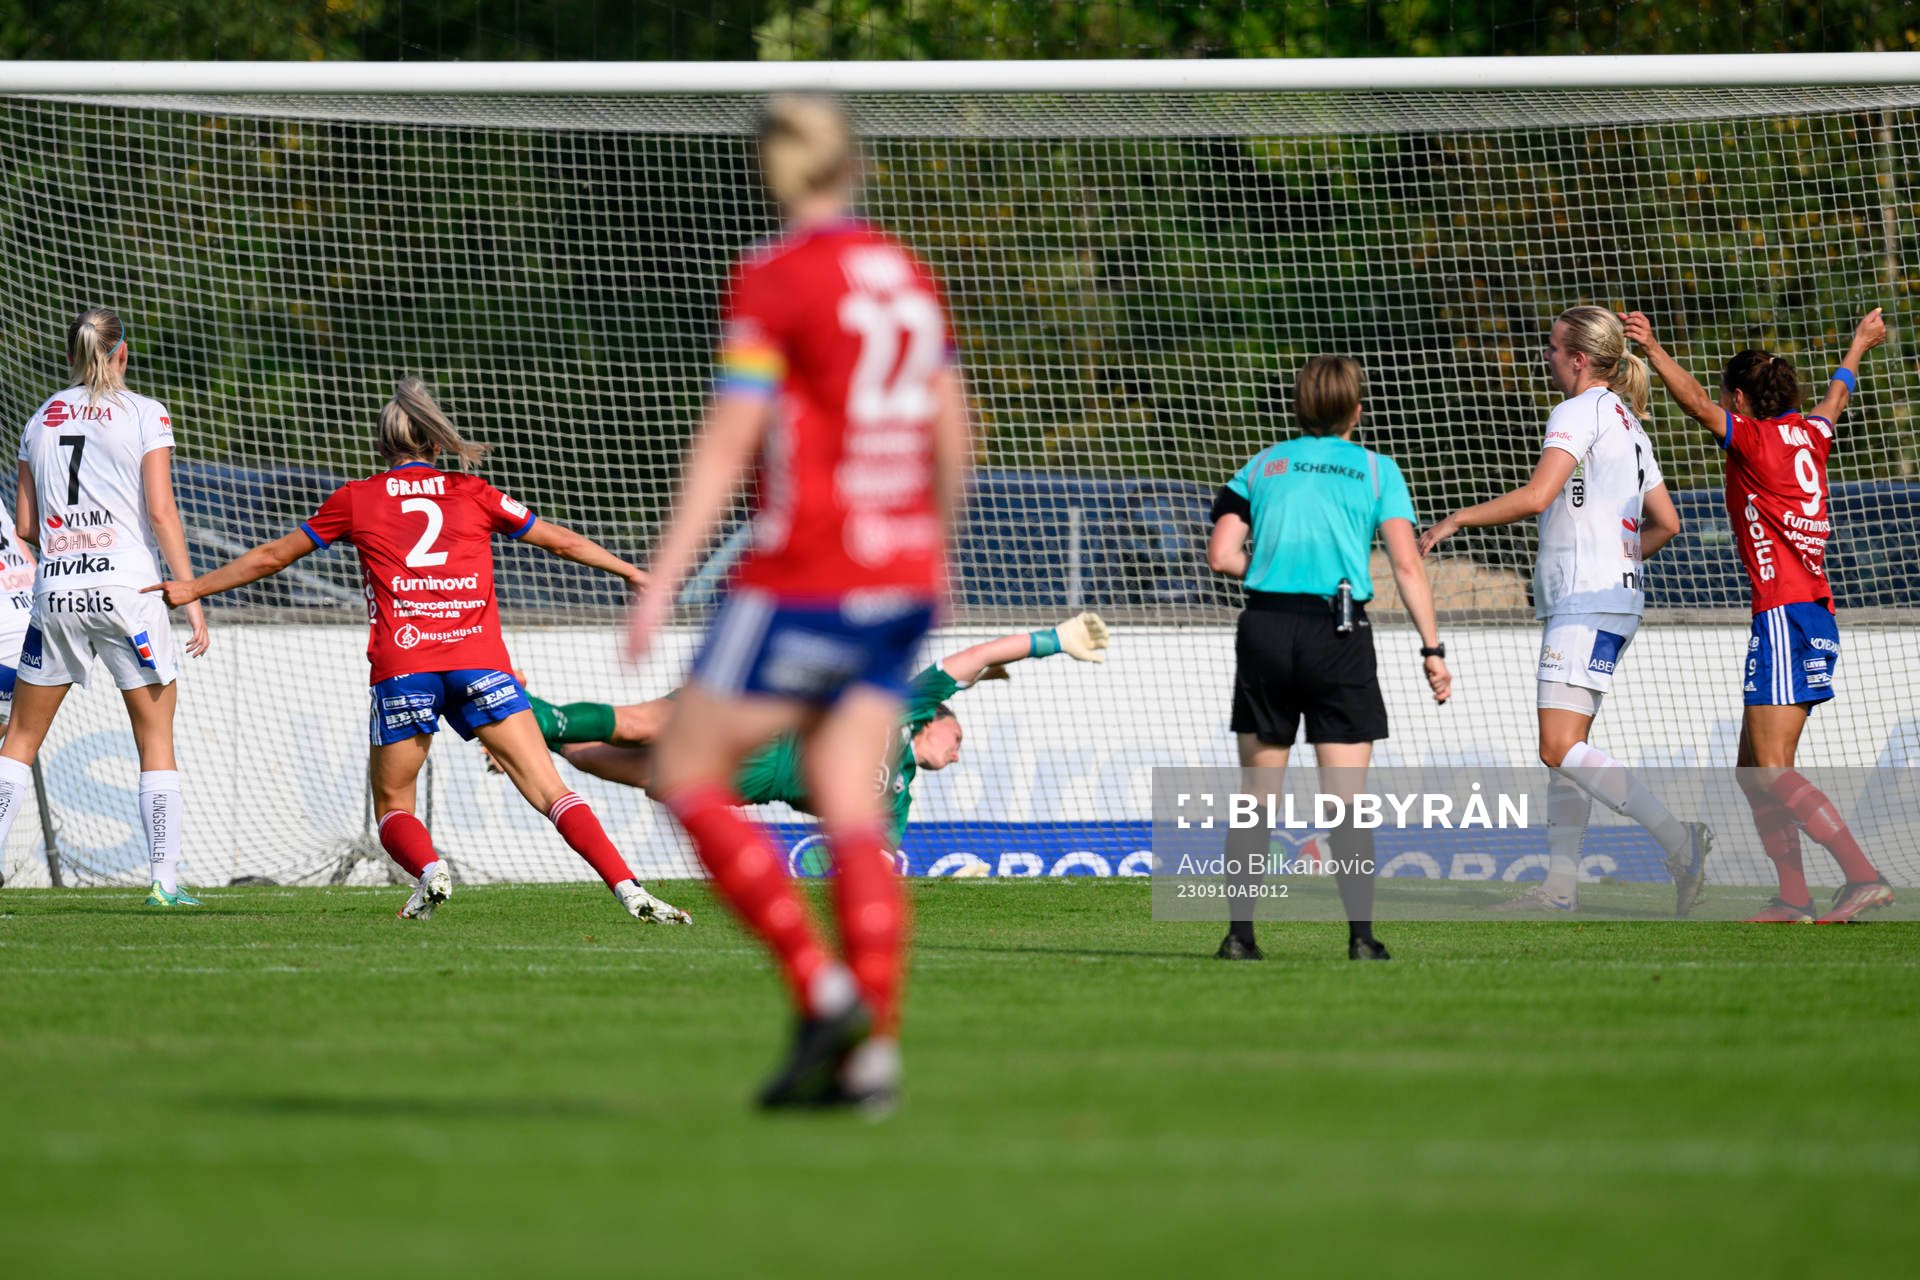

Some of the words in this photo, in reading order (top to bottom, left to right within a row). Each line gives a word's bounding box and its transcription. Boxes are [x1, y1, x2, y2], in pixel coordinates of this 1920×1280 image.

[839, 290, 943, 423] 22
[59, 435, 85, 505] 7
[1266, 460, 1286, 474] DB
[1293, 462, 1366, 481] SCHENKER
[1794, 448, 1822, 516] 9
[386, 475, 446, 496] GRANT
[1572, 478, 1584, 508] GBJ
[64, 509, 113, 528] VISMA
[48, 532, 113, 554] LOHILO
[401, 498, 449, 568] 2
[48, 591, 114, 613] friskis
[421, 625, 483, 640] MUSIKHUSET
[152, 793, 167, 863] KUNGSGRILLEN
